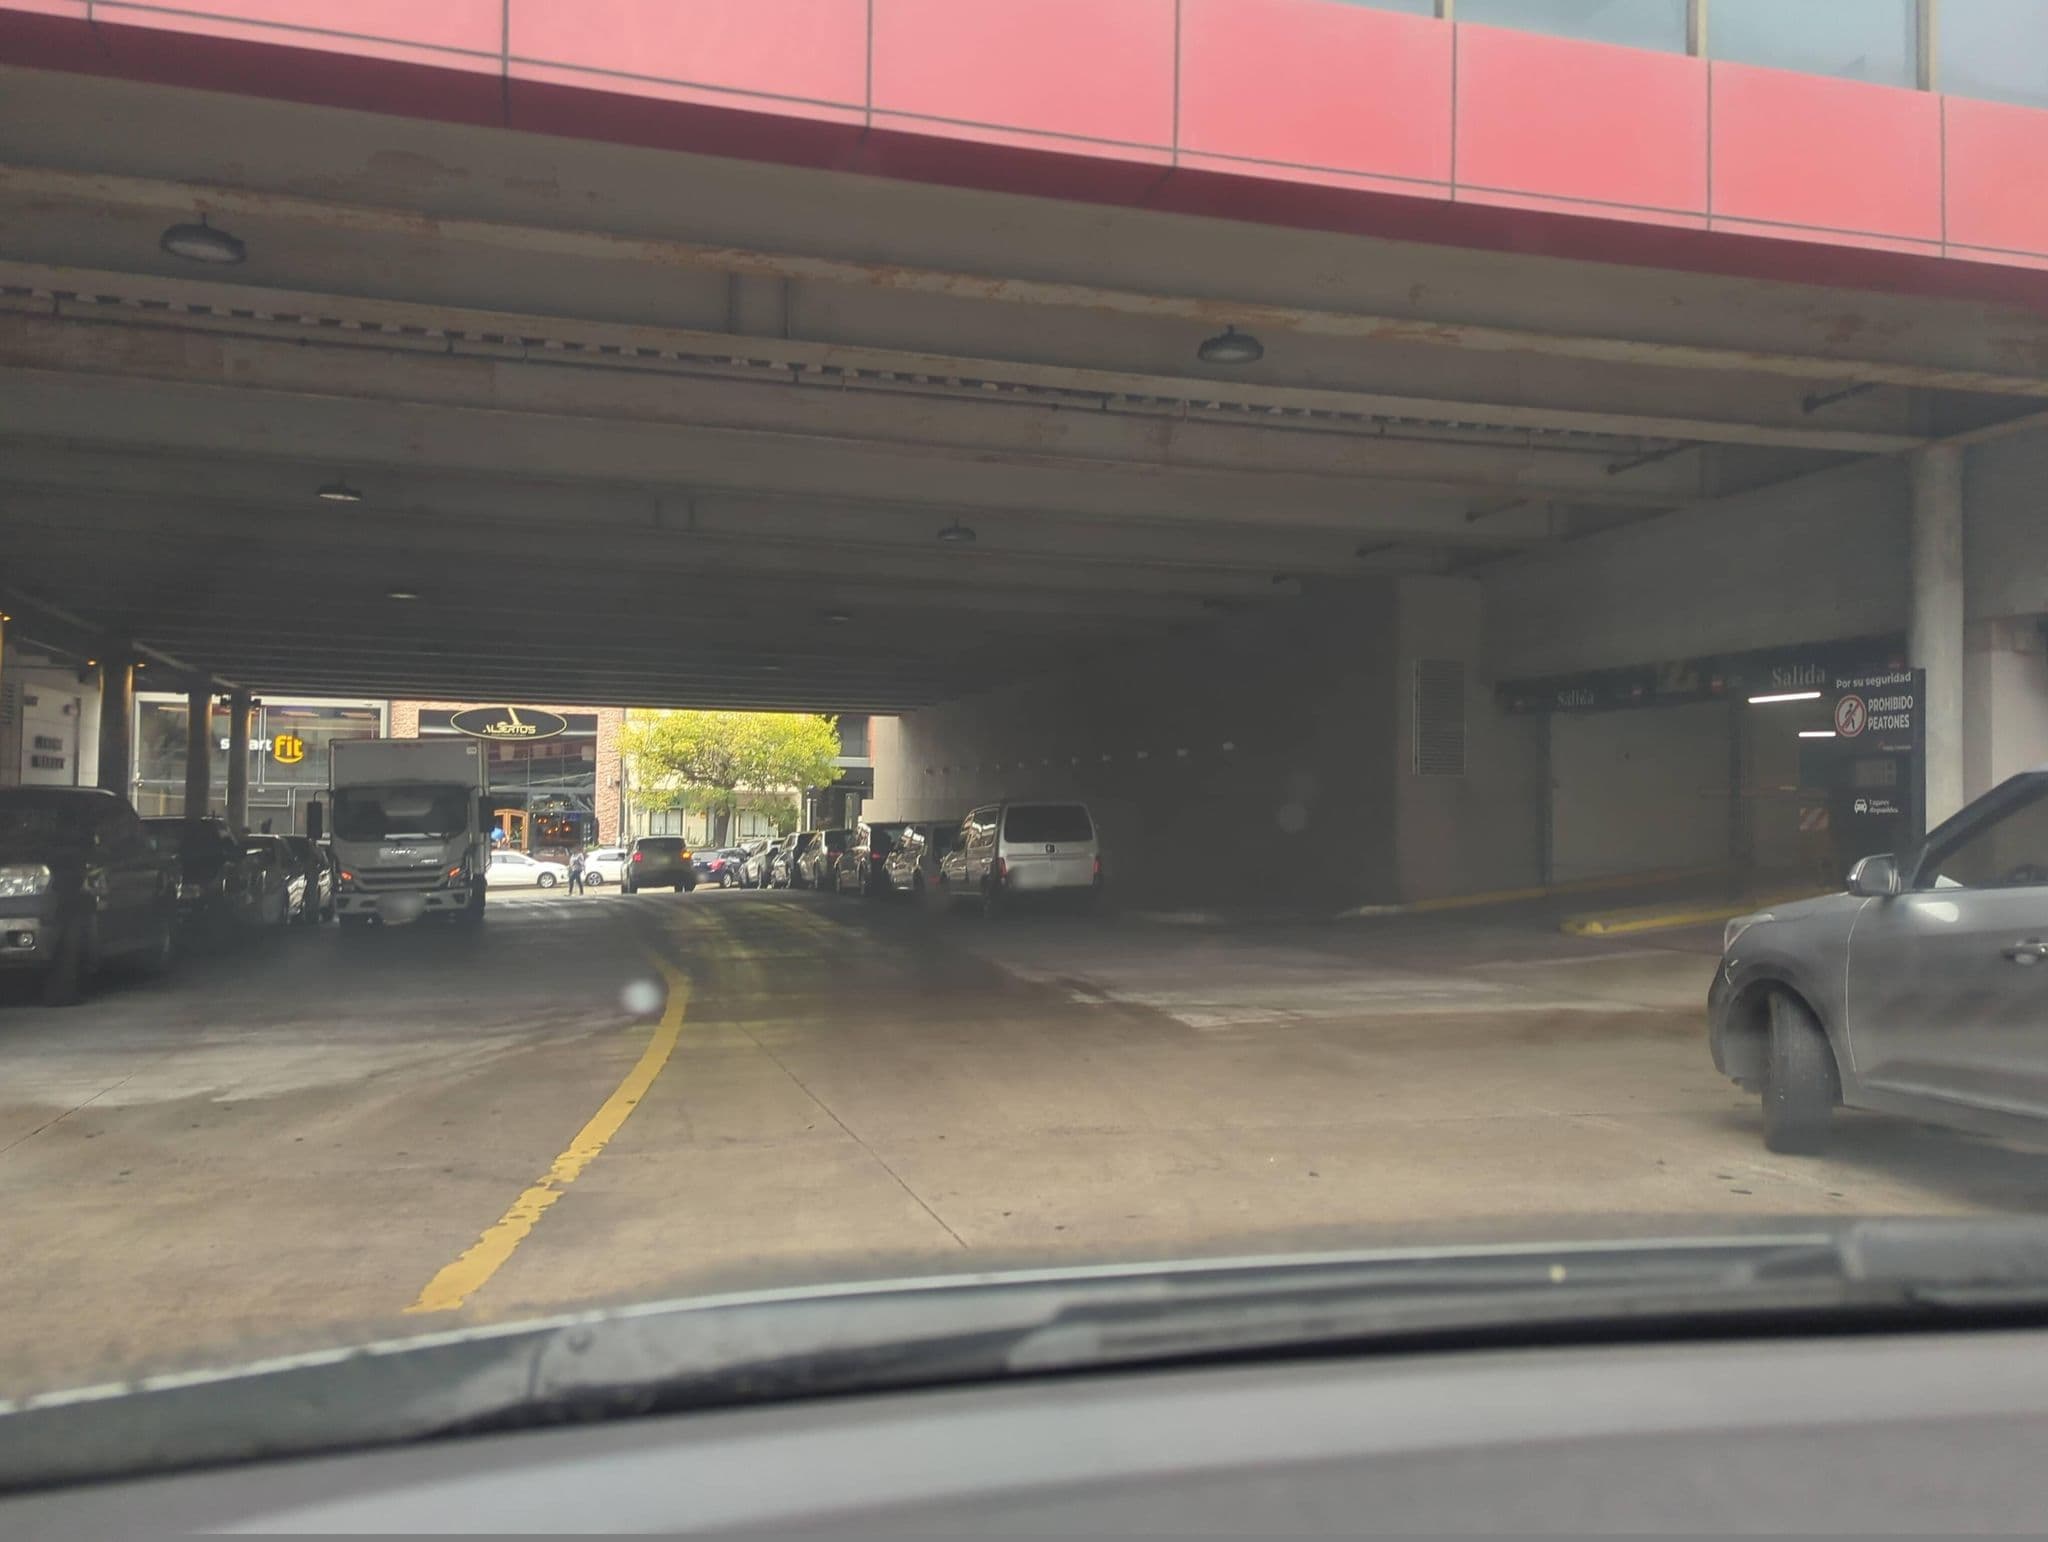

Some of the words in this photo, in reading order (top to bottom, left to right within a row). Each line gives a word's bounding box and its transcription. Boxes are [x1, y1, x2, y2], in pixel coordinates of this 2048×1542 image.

[1772, 664, 1825, 688] Salida
[1836, 679, 1851, 688] Por
[1853, 679, 1864, 687] su
[1866, 672, 1912, 687] seguridad
[1868, 695, 1914, 712] PROHIBIDO
[1868, 714, 1910, 730] PEATONES
[220, 738, 272, 751] sart
